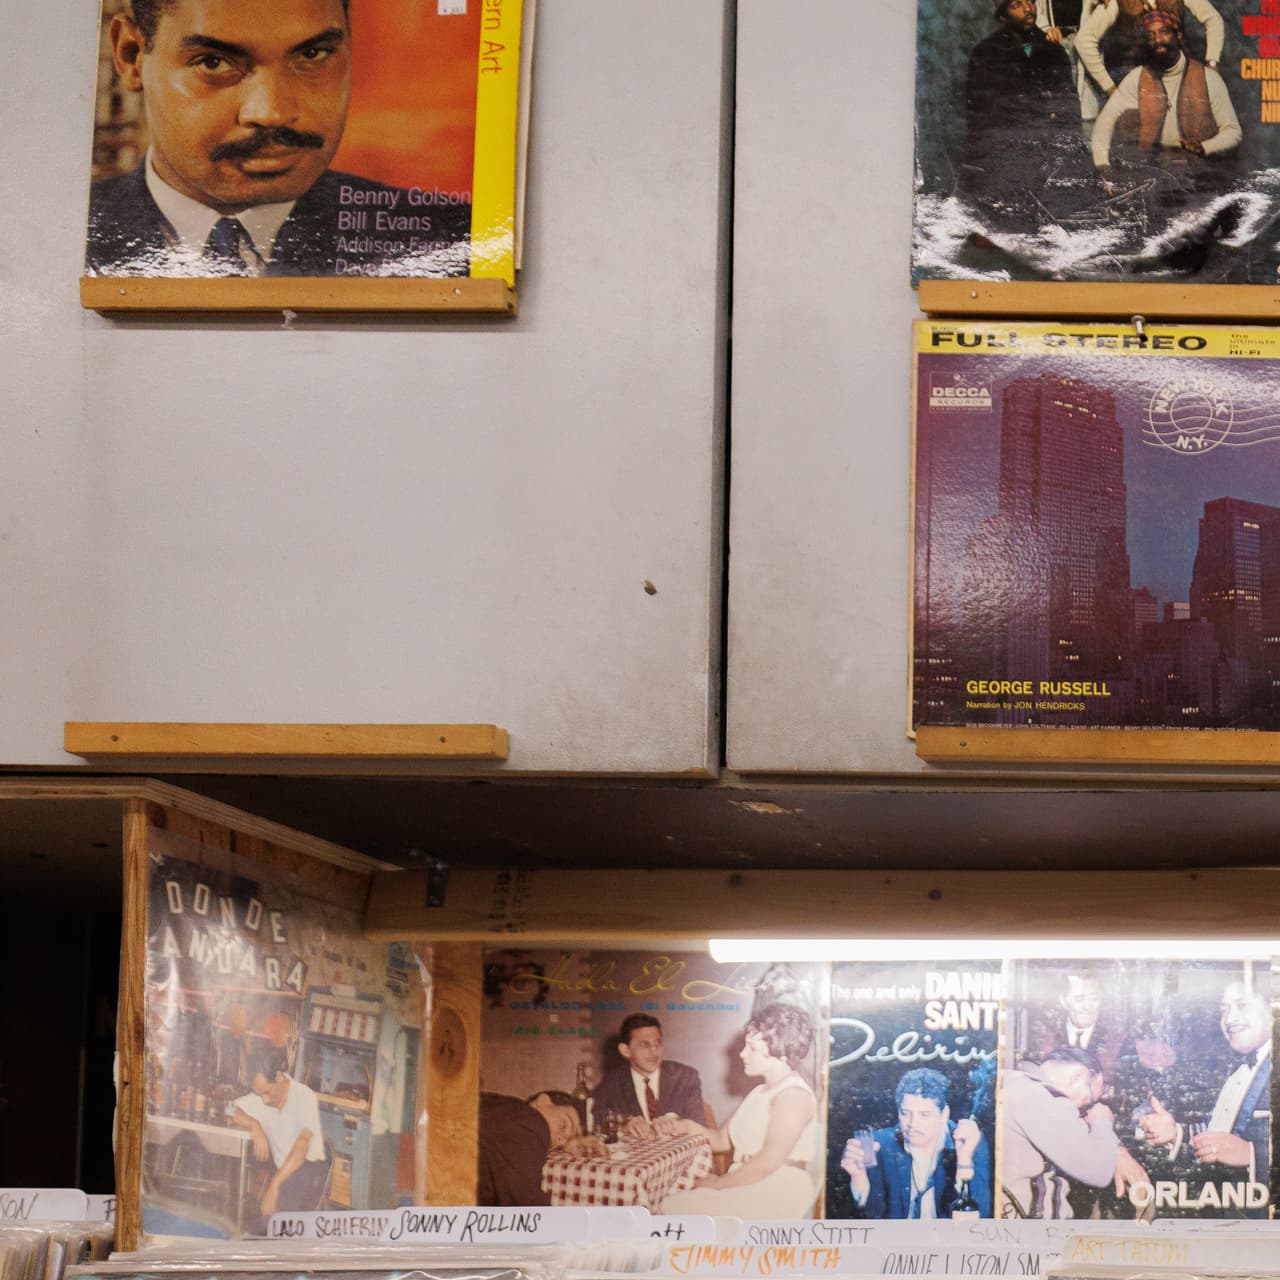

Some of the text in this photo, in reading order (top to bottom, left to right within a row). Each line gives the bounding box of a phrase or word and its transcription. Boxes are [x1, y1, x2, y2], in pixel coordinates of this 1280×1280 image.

[481, 40, 505, 73] Art
[339, 185, 472, 208] Benny Golson
[338, 211, 432, 230] Bill Evans
[336, 236, 402, 252] Addison
[931, 331, 1208, 350] FULL STEREO
[932, 386, 990, 398] DECCA
[1175, 434, 1208, 450] N.Y.
[966, 680, 1111, 696] GEORGE RUSSELL
[966, 701, 1086, 711] Narration by JON HENDRICKS
[271, 1216, 306, 1239] LALO
[389, 1207, 543, 1244] SONNY ROLLINS
[808, 1226, 876, 1246] STITT
[668, 1246, 842, 1277] JIMMY SMITH
